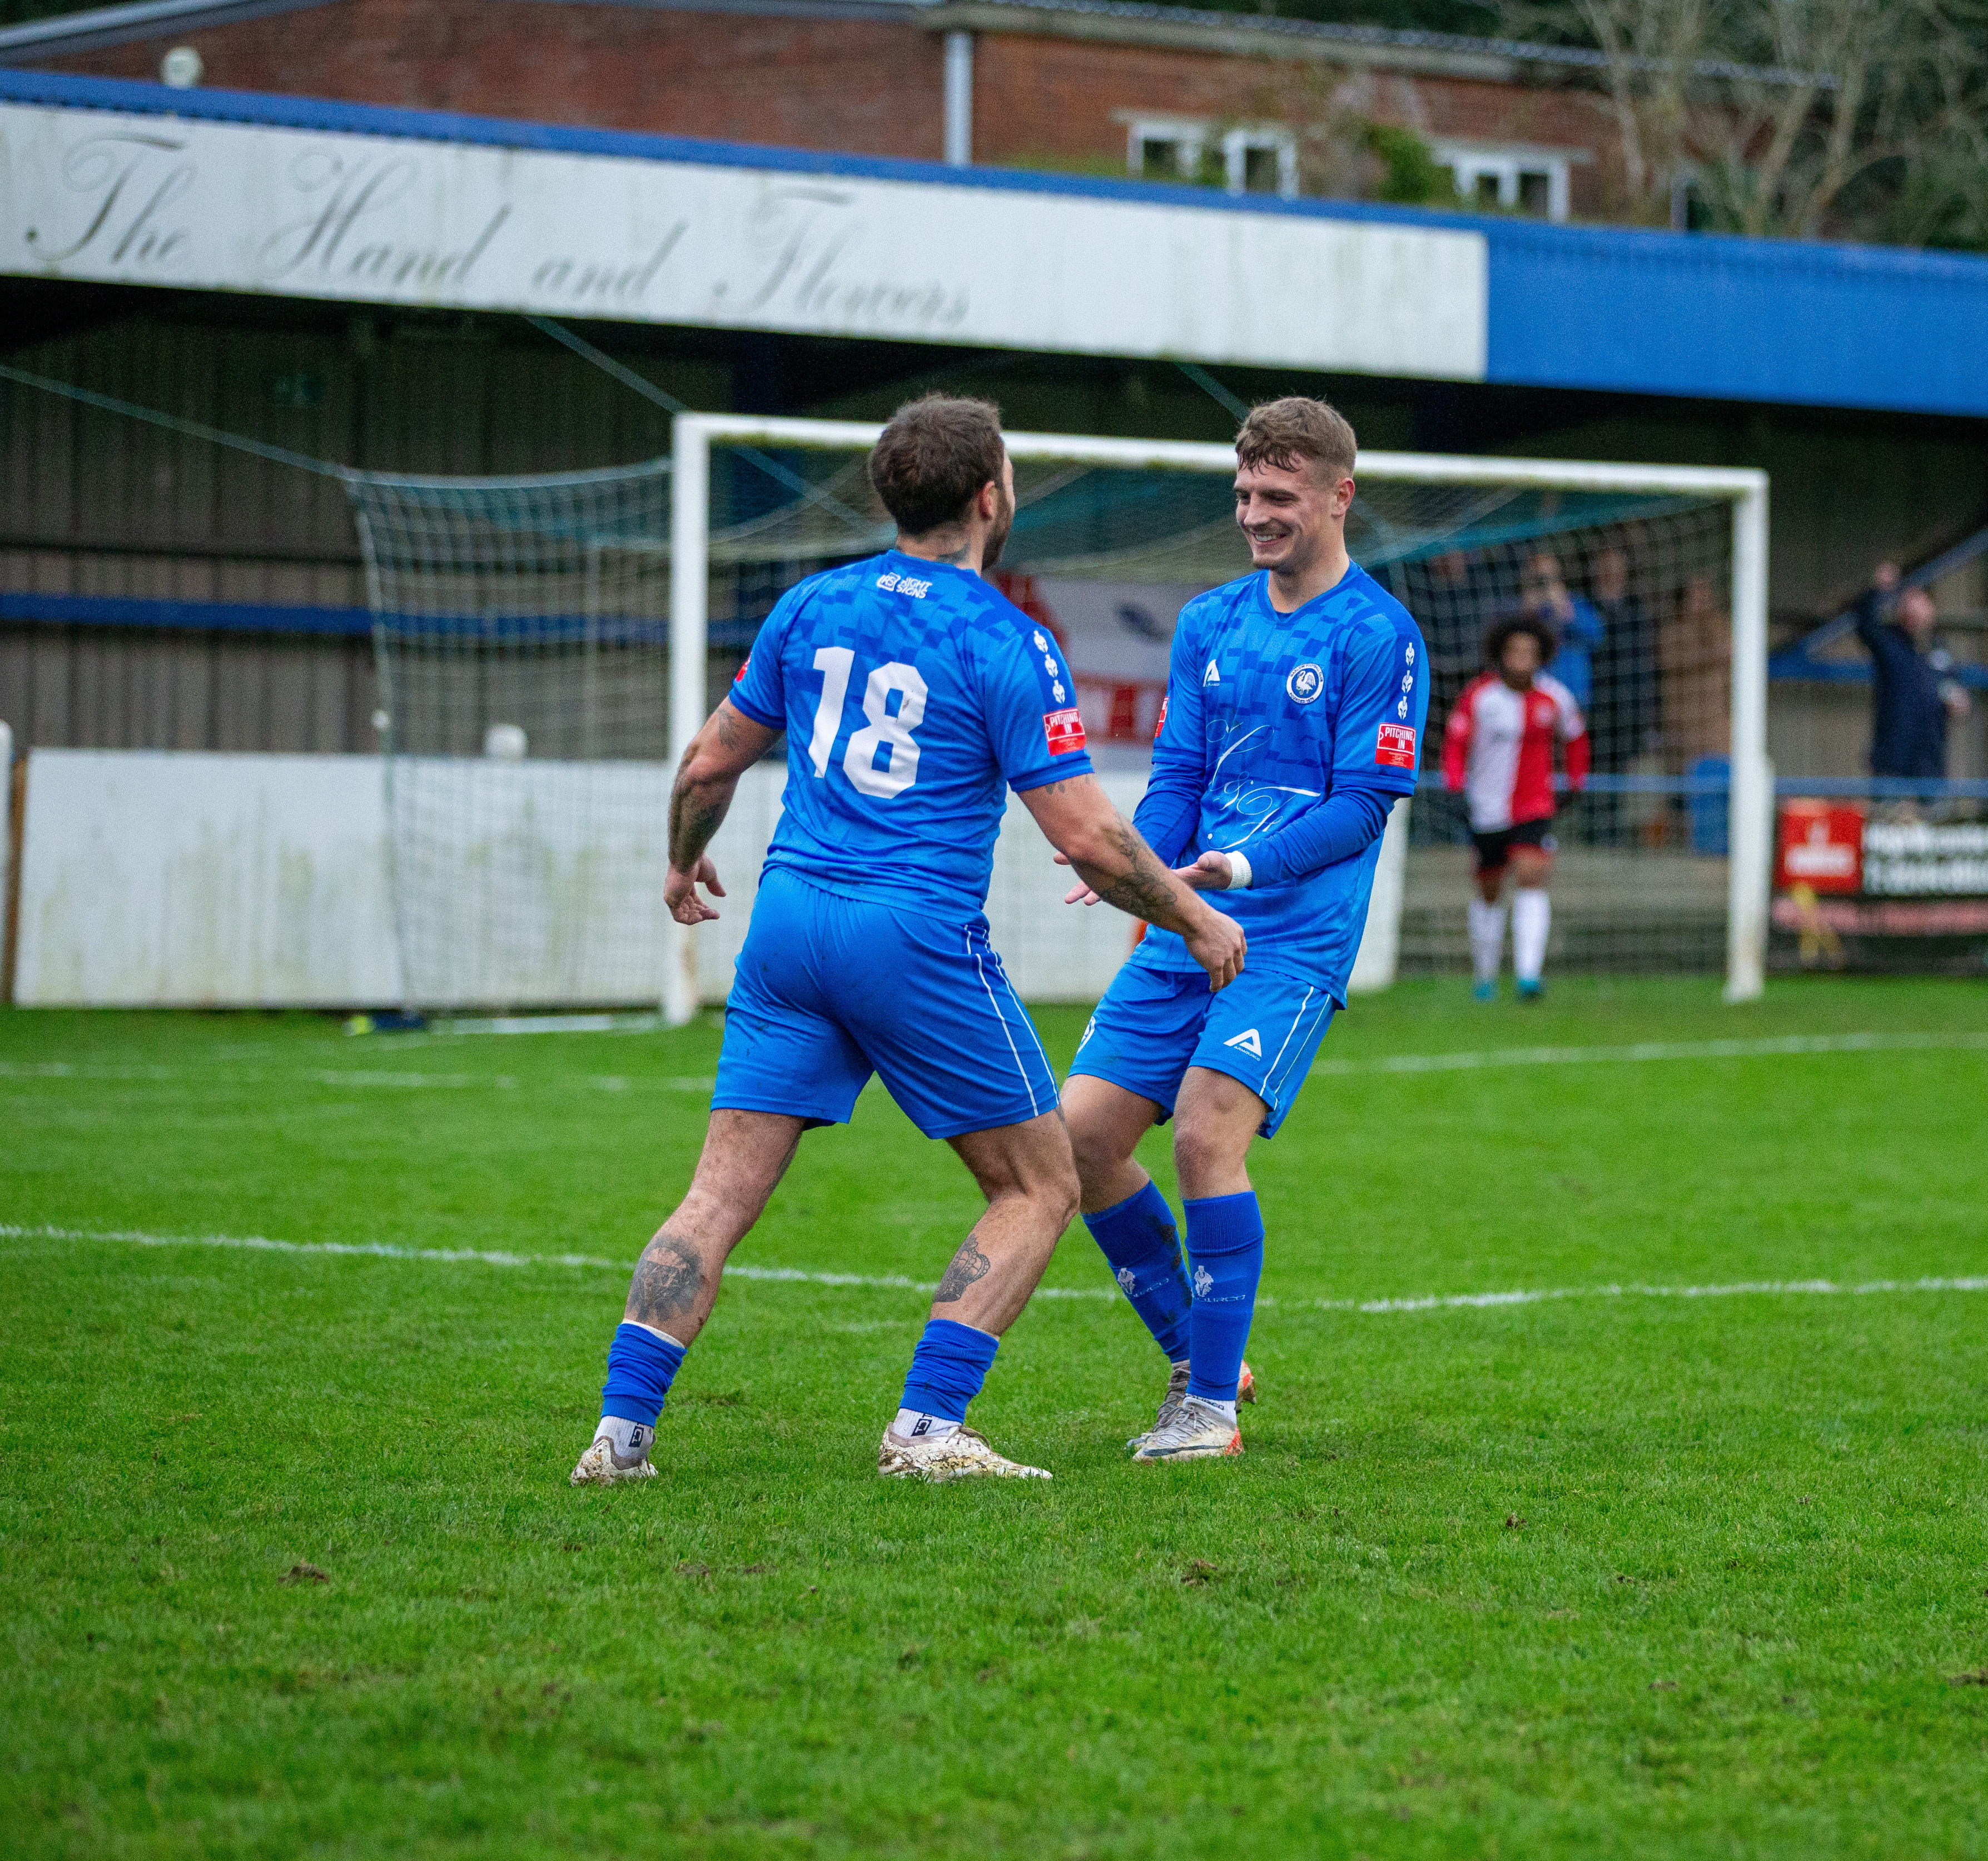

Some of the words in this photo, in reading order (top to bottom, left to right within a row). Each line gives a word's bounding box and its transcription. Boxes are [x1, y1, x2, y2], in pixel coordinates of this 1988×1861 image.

[24, 131, 198, 263] The
[257, 146, 514, 285] Hand
[531, 221, 689, 299] and
[711, 185, 972, 328] Flowers
[896, 584, 928, 599] SIGNS
[808, 646, 928, 799] 18
[1050, 712, 1079, 727] PITCHING
[1065, 722, 1072, 734] IN
[1384, 727, 1413, 742] PITCHING
[1398, 739, 1405, 749] IN
